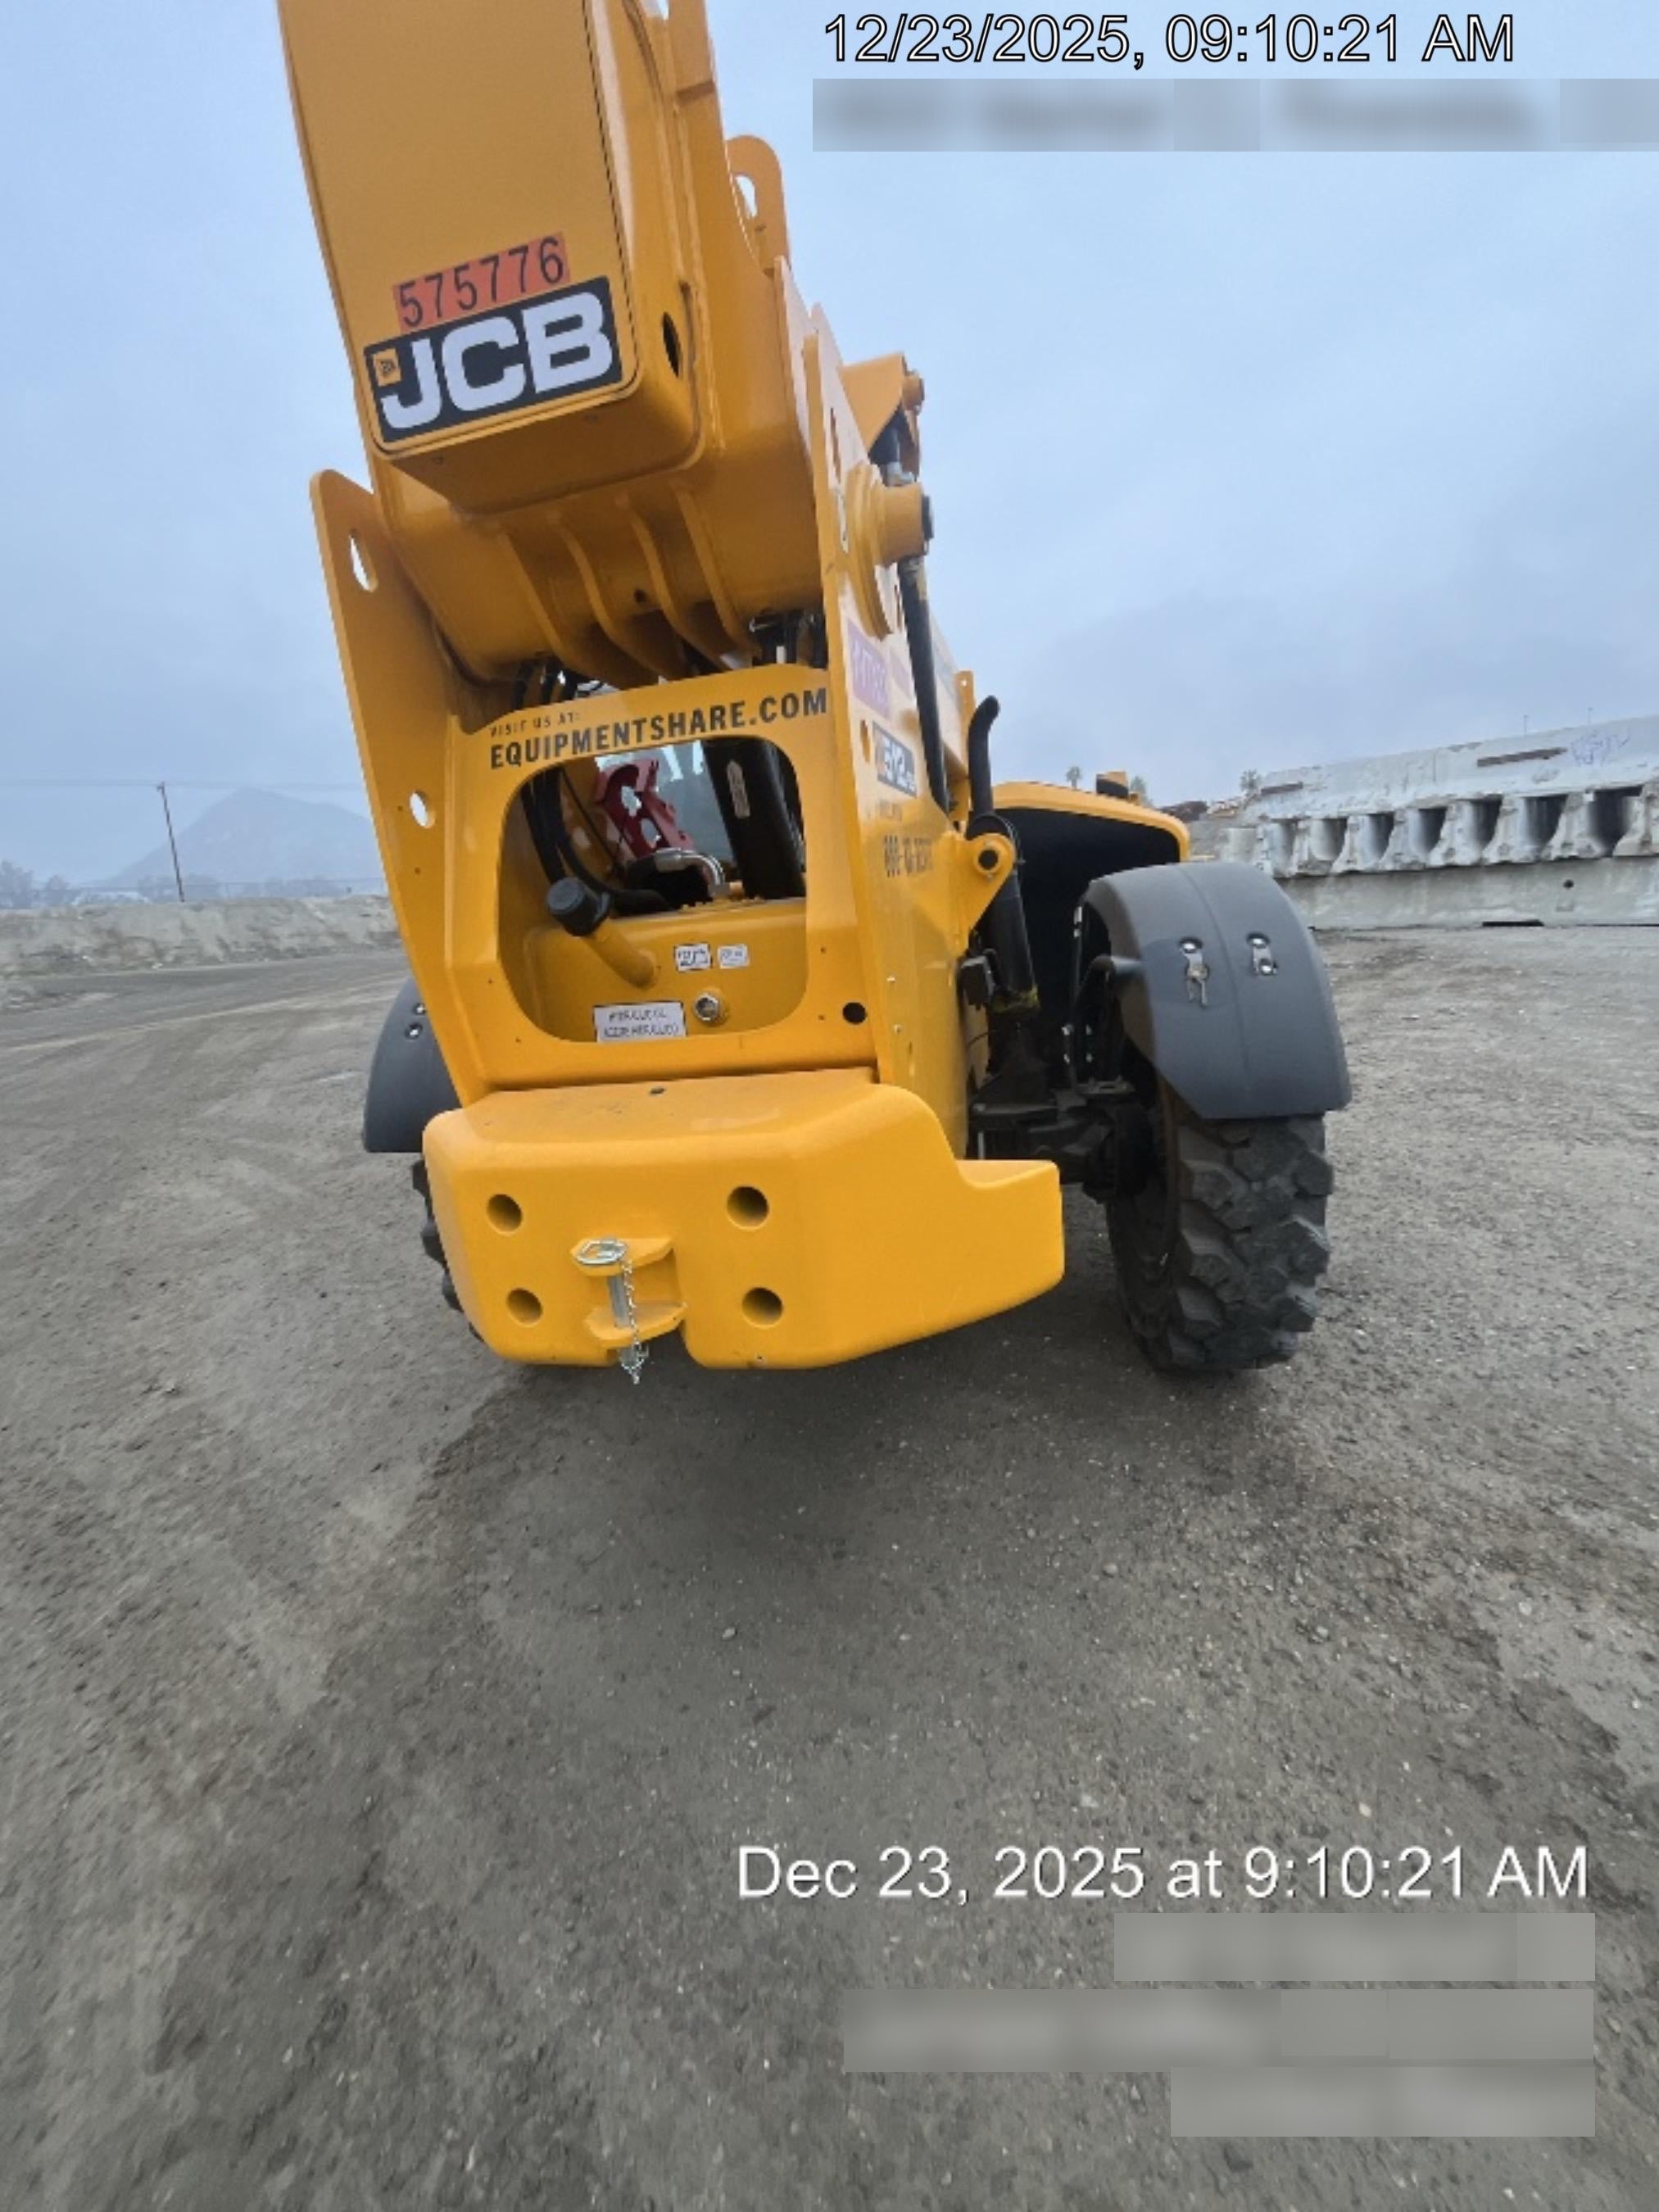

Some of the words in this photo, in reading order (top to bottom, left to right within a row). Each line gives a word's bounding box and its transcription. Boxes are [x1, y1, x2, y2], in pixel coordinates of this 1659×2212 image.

[399, 236, 564, 328] 575776
[380, 291, 613, 429] JCB
[491, 687, 827, 770] EQUIPMENTSHARE.COM
[533, 716, 551, 728] US
